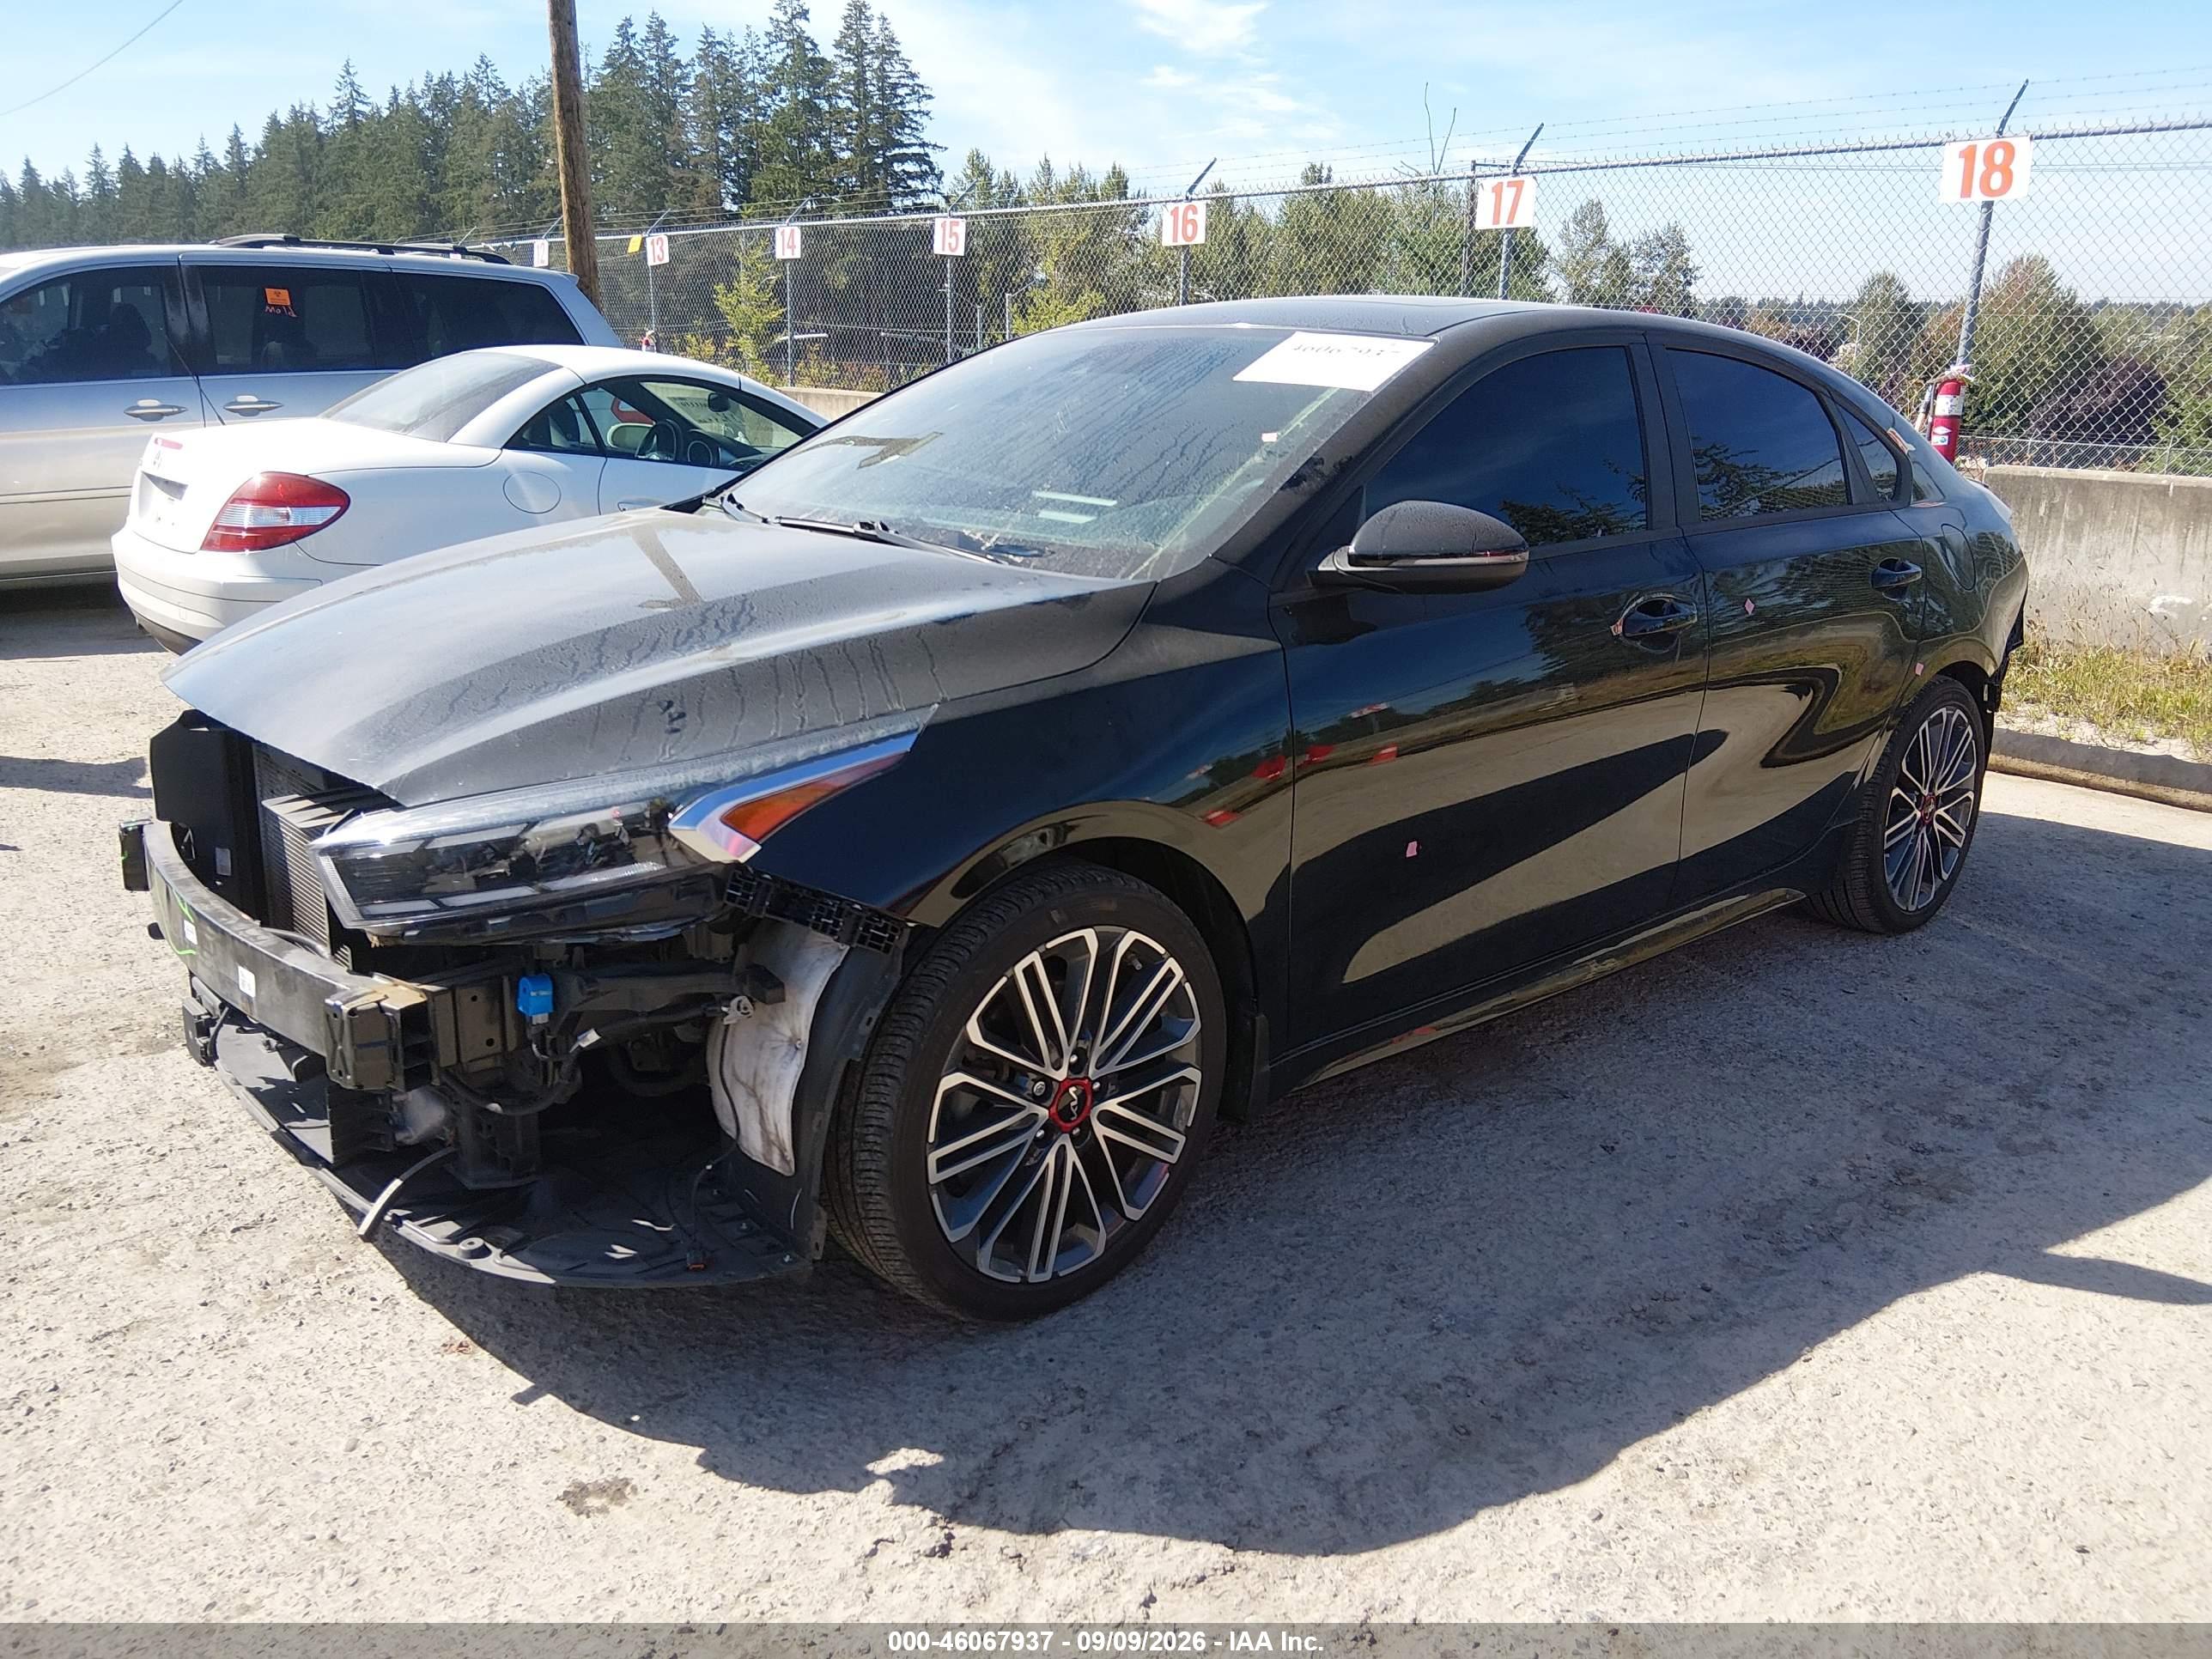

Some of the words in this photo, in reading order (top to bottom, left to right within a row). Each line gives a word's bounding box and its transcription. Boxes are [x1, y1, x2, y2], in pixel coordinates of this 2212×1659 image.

[1958, 140, 2015, 198] 18
[1492, 179, 1525, 225] 17
[940, 220, 960, 252] 15
[1170, 204, 1198, 243] 16
[650, 236, 665, 264] 13
[781, 228, 797, 257] 14
